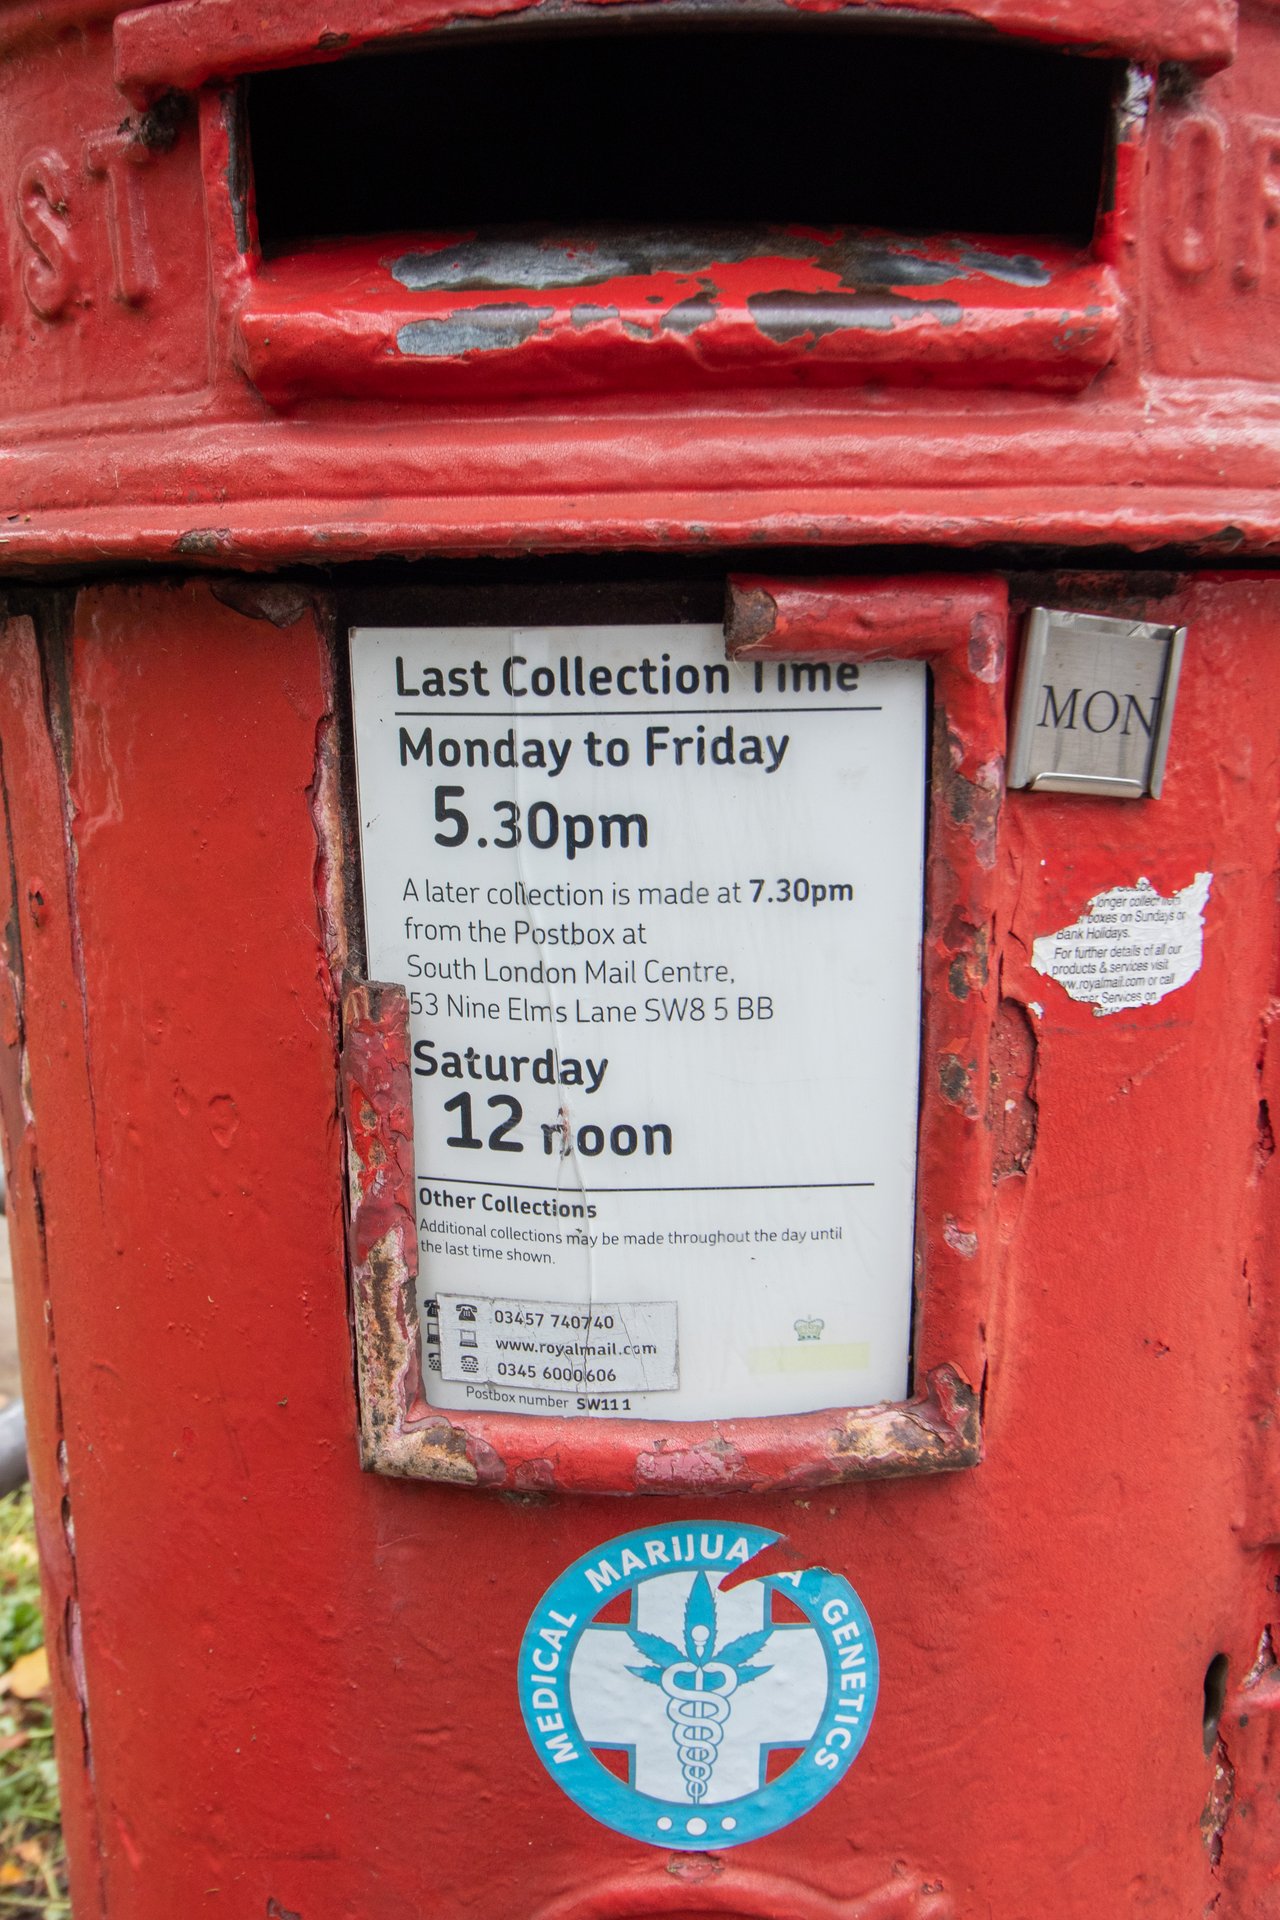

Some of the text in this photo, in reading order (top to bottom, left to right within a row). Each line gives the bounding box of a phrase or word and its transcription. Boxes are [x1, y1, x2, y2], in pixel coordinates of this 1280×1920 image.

[395, 655, 491, 698] Last
[502, 653, 730, 698] Collection
[1036, 684, 1162, 738] MON
[398, 725, 790, 778] Monday to Friday
[433, 784, 649, 860] 5.30pm
[402, 877, 854, 908] A later collection is made at 7.30pm
[1095, 896, 1127, 911] longer
[1129, 896, 1160, 907] collect
[404, 916, 648, 947] from the Postbox at
[1120, 912, 1133, 923] on
[1135, 909, 1175, 924] Sundays
[1176, 910, 1187, 921] or
[1056, 926, 1131, 941] Bank Holidays.
[1054, 943, 1183, 959] For further details of all our
[406, 953, 735, 985] South London Mail Centre,
[1052, 958, 1169, 976] products & services visit
[1148, 977, 1157, 987] or
[1160, 972, 1176, 985] call
[410, 991, 774, 1024] 53 Nine Elms Lane SW8 5 BB
[1101, 990, 1142, 1003] Services
[412, 1040, 610, 1094] Saturday
[443, 1090, 673, 1158] 12 noon
[418, 1186, 598, 1219] Other Collections
[418, 1218, 843, 1249] Additional collections may be made throughout the day until
[419, 1240, 556, 1265] the last time shown.
[493, 1309, 615, 1330] 03457 740740
[495, 1338, 658, 1357] www.royalmail.com
[497, 1362, 537, 1379] 0345
[466, 1385, 517, 1404] Postbox
[518, 1392, 570, 1409] number
[583, 1533, 804, 1594] MARIJUAA
[532, 1609, 578, 1764] MEDICAL
[814, 1599, 867, 1771] GENETICS
